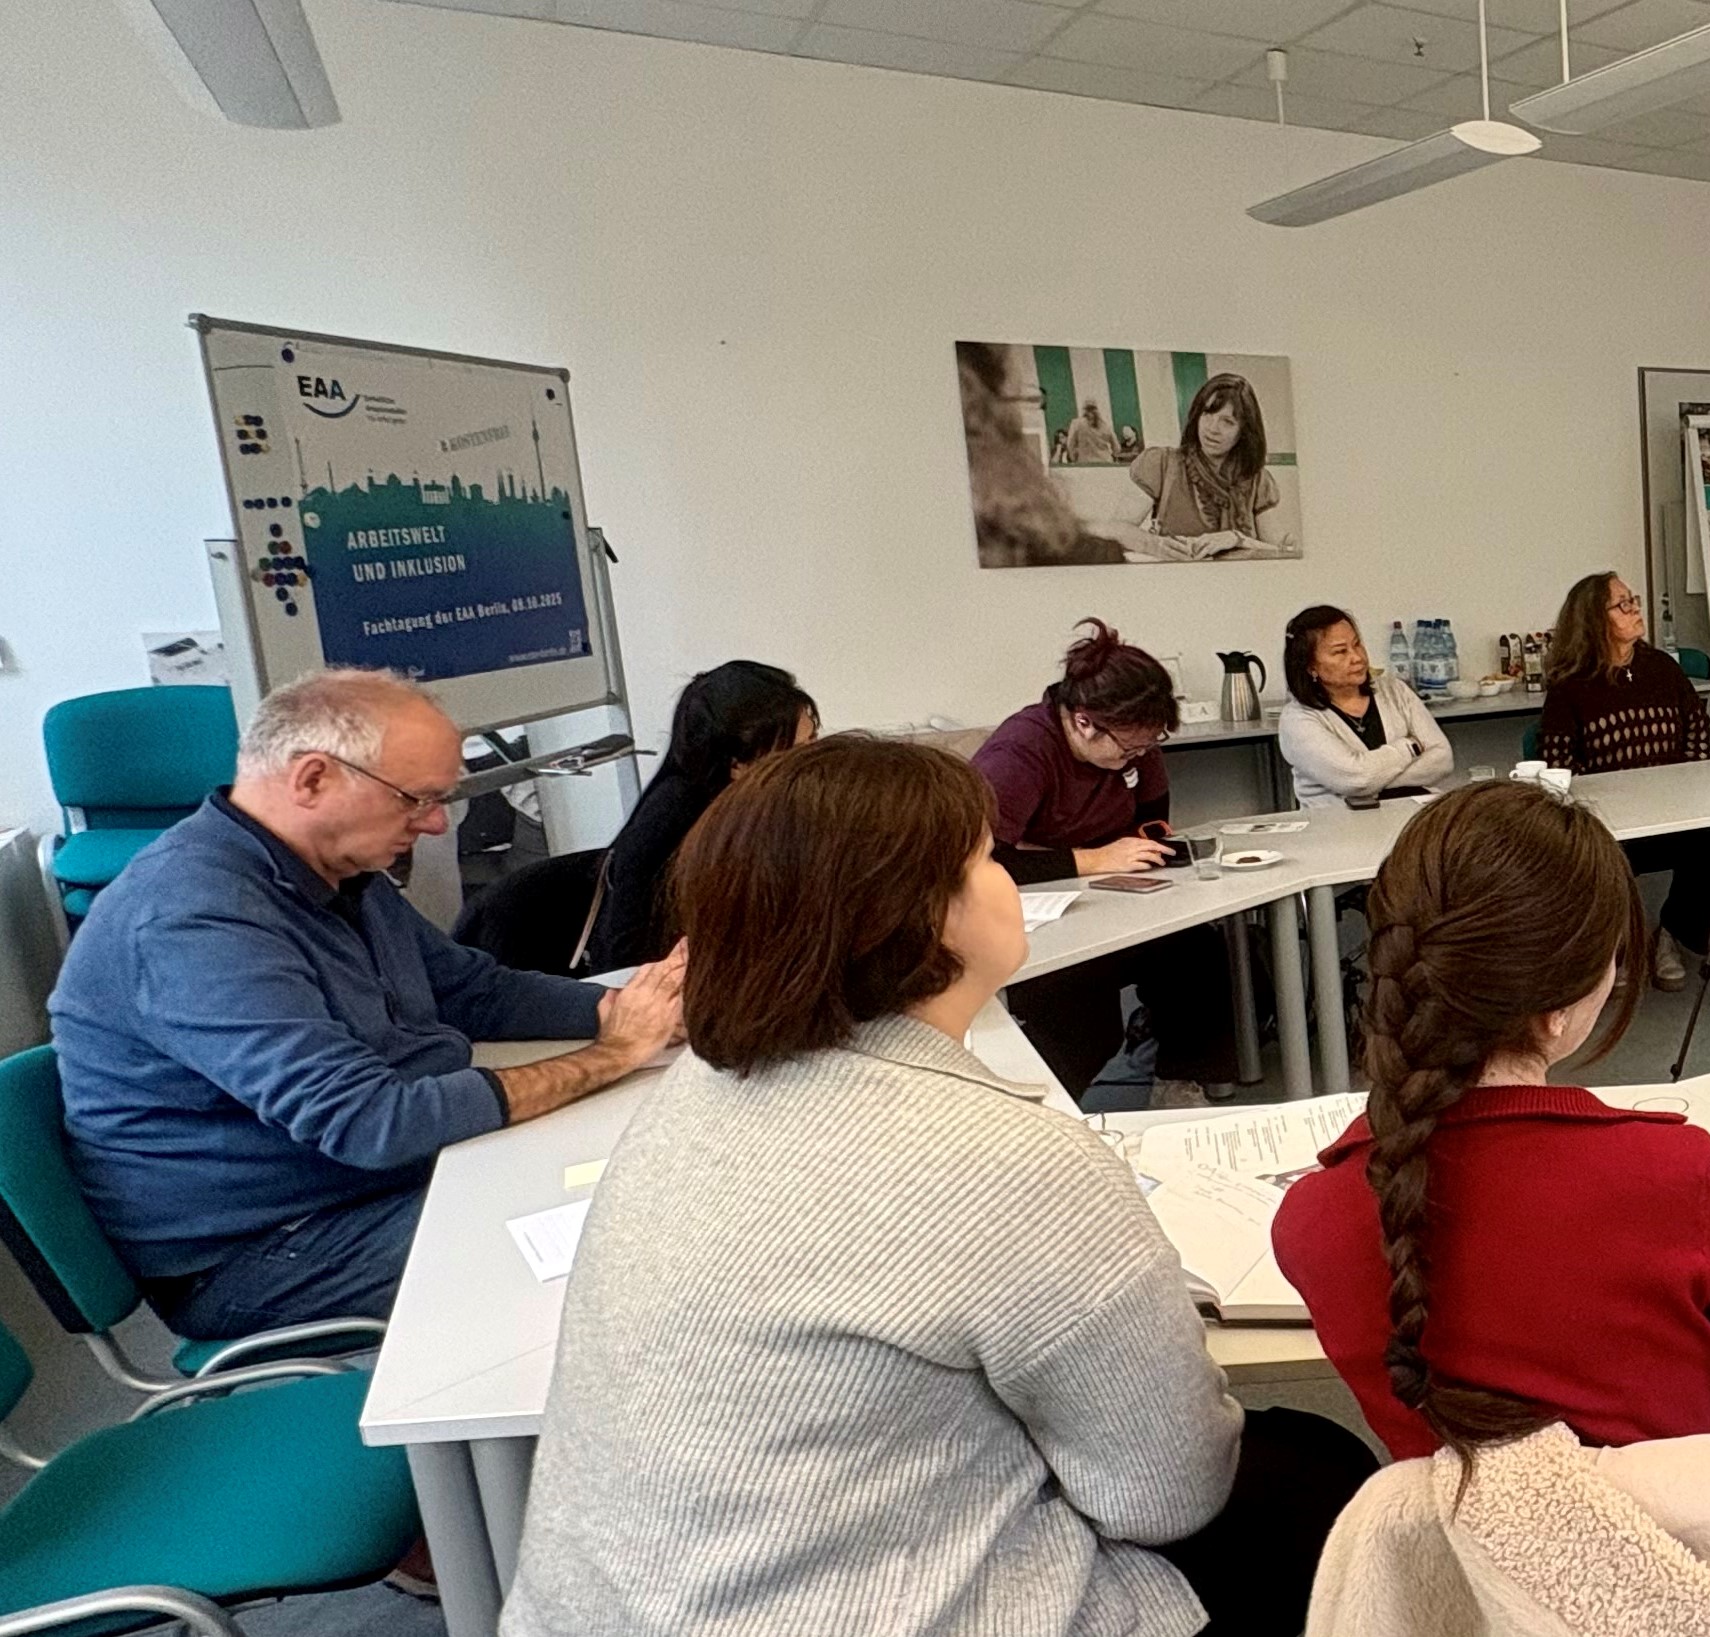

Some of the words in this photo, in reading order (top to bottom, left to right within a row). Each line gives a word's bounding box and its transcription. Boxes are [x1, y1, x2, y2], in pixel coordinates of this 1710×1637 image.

[297, 376, 347, 400] EAA
[347, 525, 446, 551] ARBEITSWELT
[352, 562, 386, 583] UND
[391, 554, 466, 579] INKLUSION
[363, 613, 434, 637] Fachtagung
[435, 610, 453, 625] der
[456, 606, 476, 622] EAA
